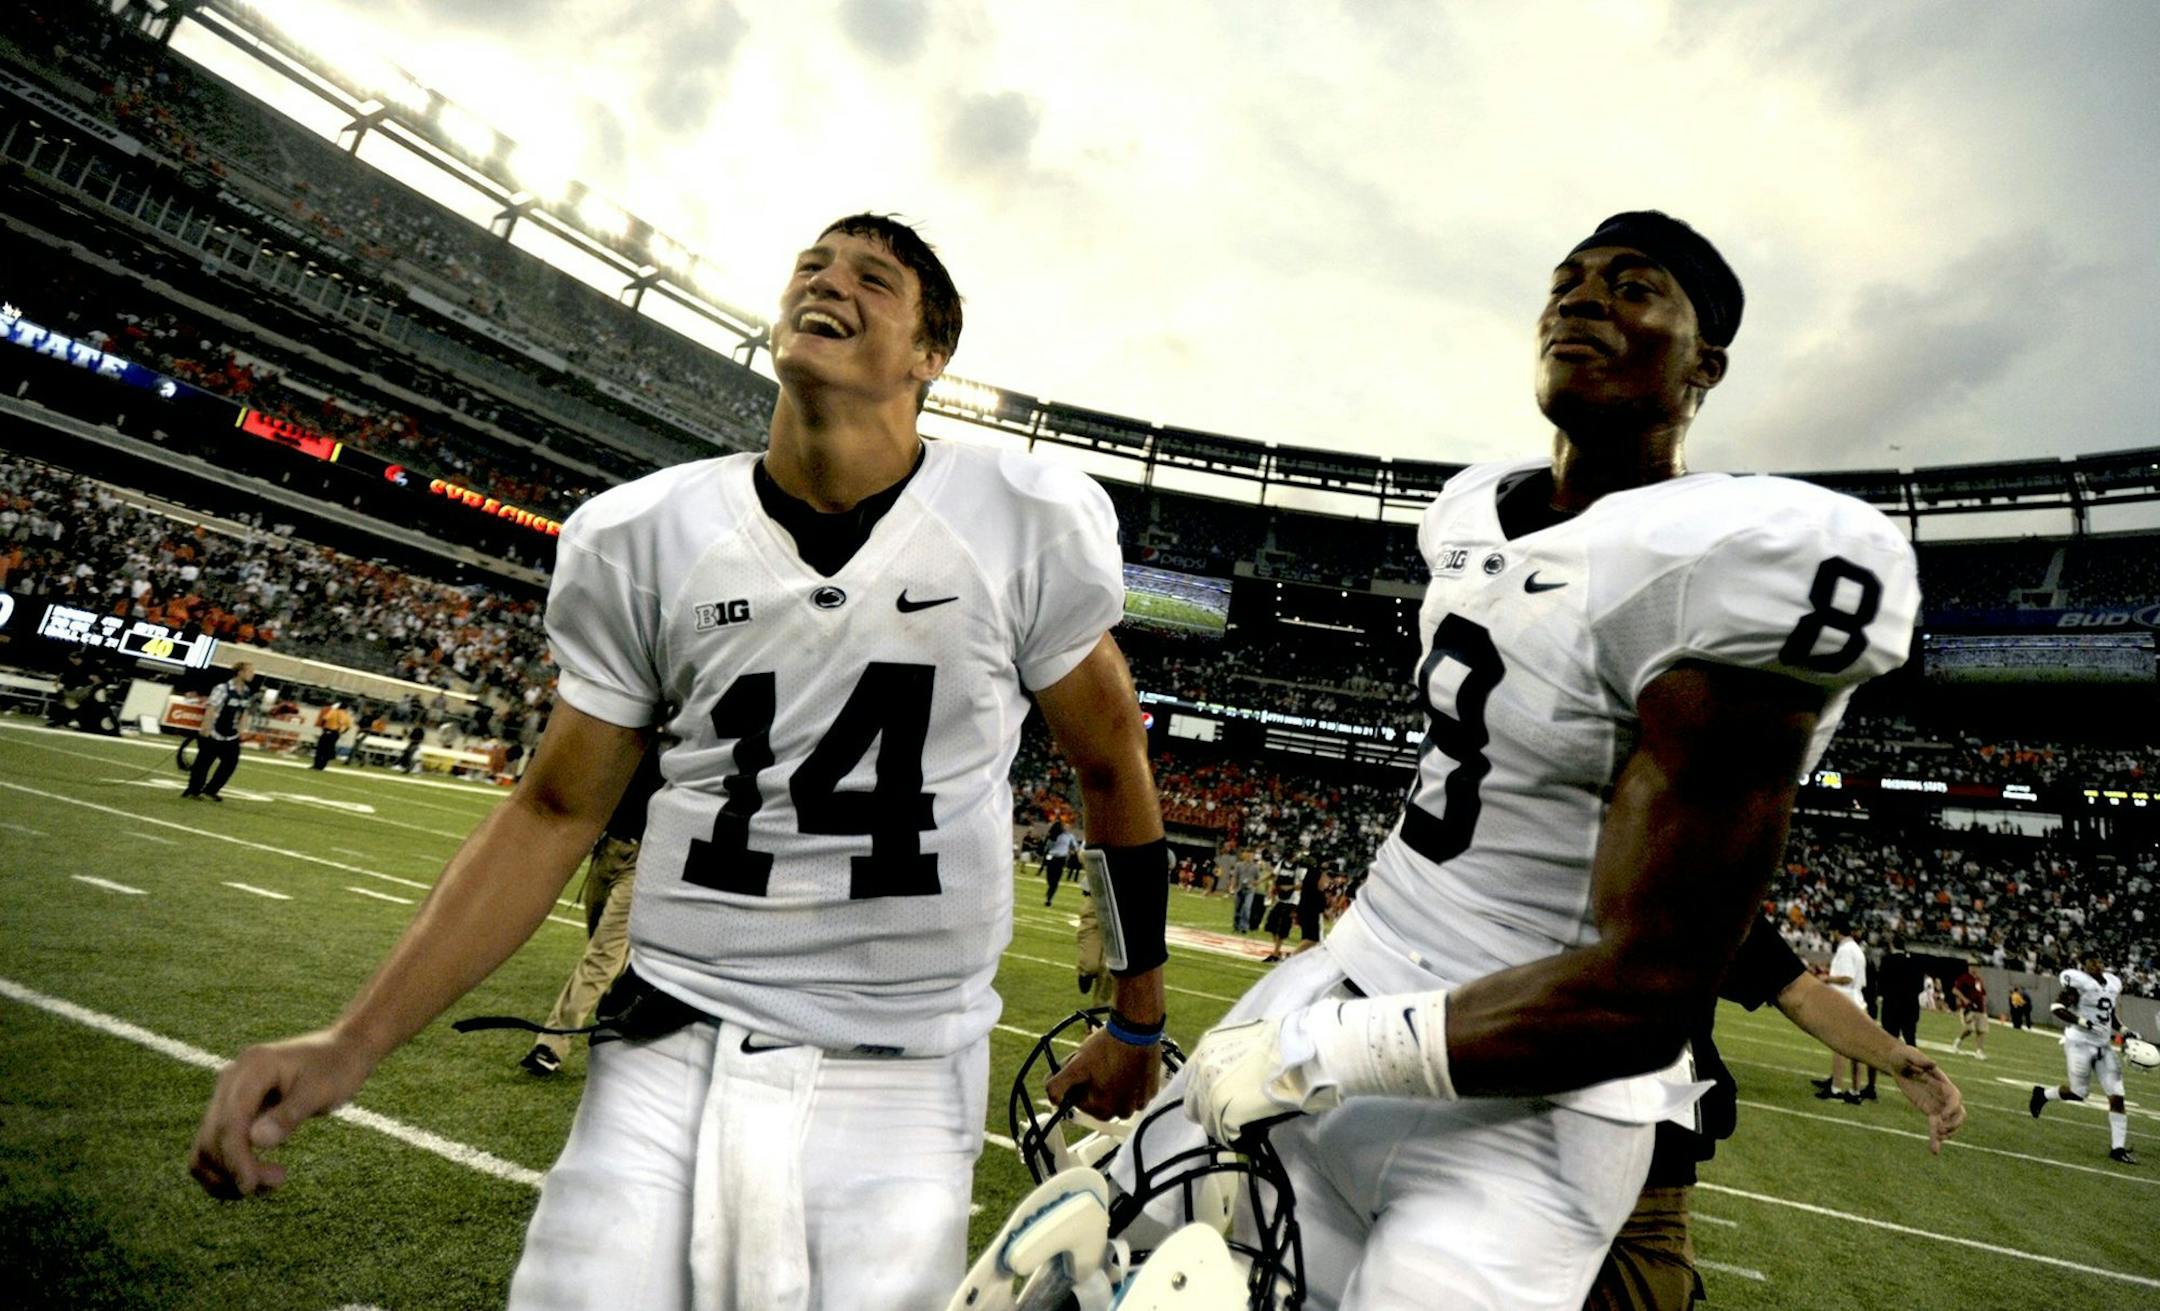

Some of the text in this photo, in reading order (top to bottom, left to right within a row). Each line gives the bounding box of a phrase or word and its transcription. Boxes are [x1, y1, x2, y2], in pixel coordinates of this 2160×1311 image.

[1160, 553, 1207, 570] pepsi
[1779, 556, 1883, 674] 8
[2056, 612, 2131, 628] BUD
[1399, 612, 1505, 864] 8
[682, 661, 942, 899] 14
[2096, 996, 2113, 1025] 9
